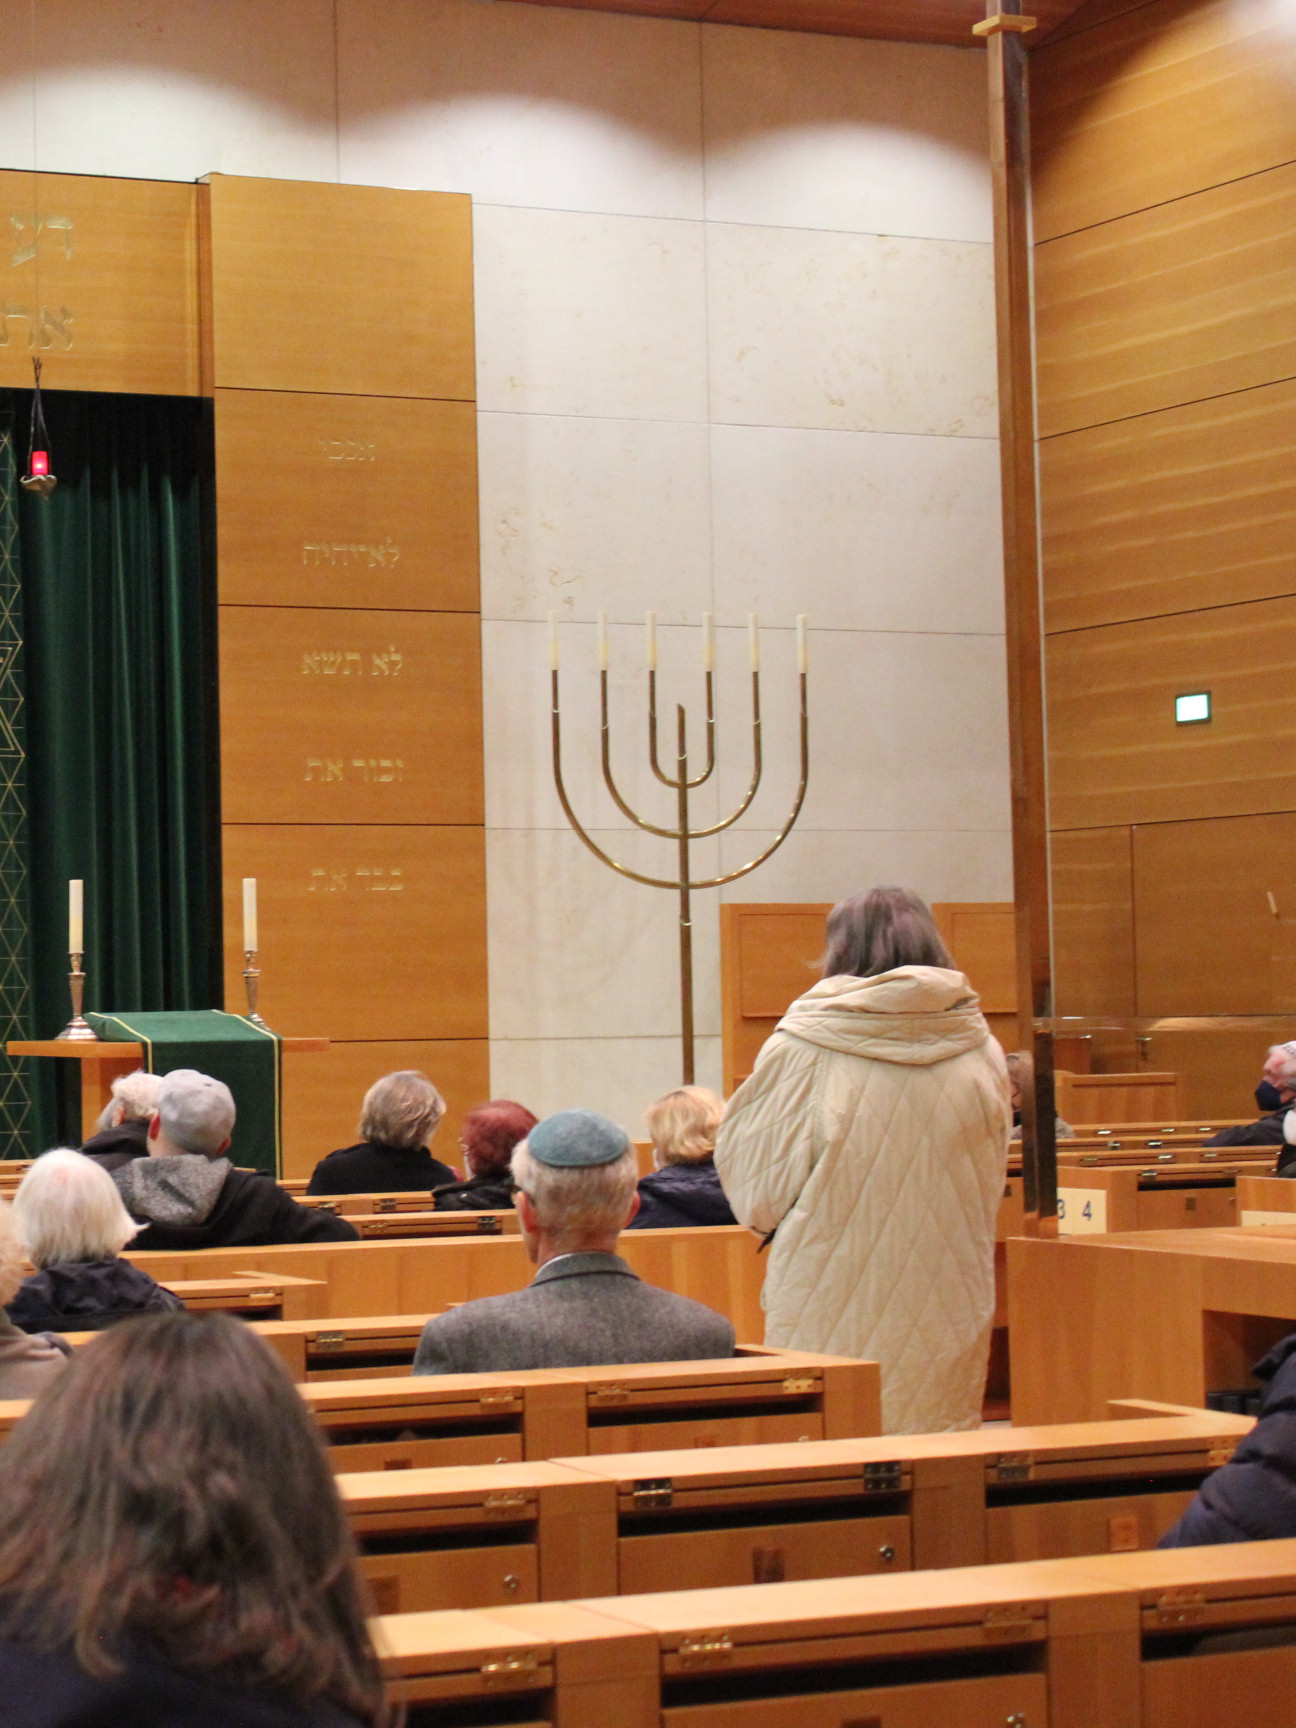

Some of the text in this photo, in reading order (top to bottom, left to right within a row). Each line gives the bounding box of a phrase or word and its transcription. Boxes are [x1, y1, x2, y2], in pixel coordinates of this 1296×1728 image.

[10, 211, 74, 267] דע
[302, 644, 403, 676] לא תשא
[304, 757, 344, 782] את
[307, 867, 404, 891] כבד את
[1081, 1200, 1092, 1222] 4
